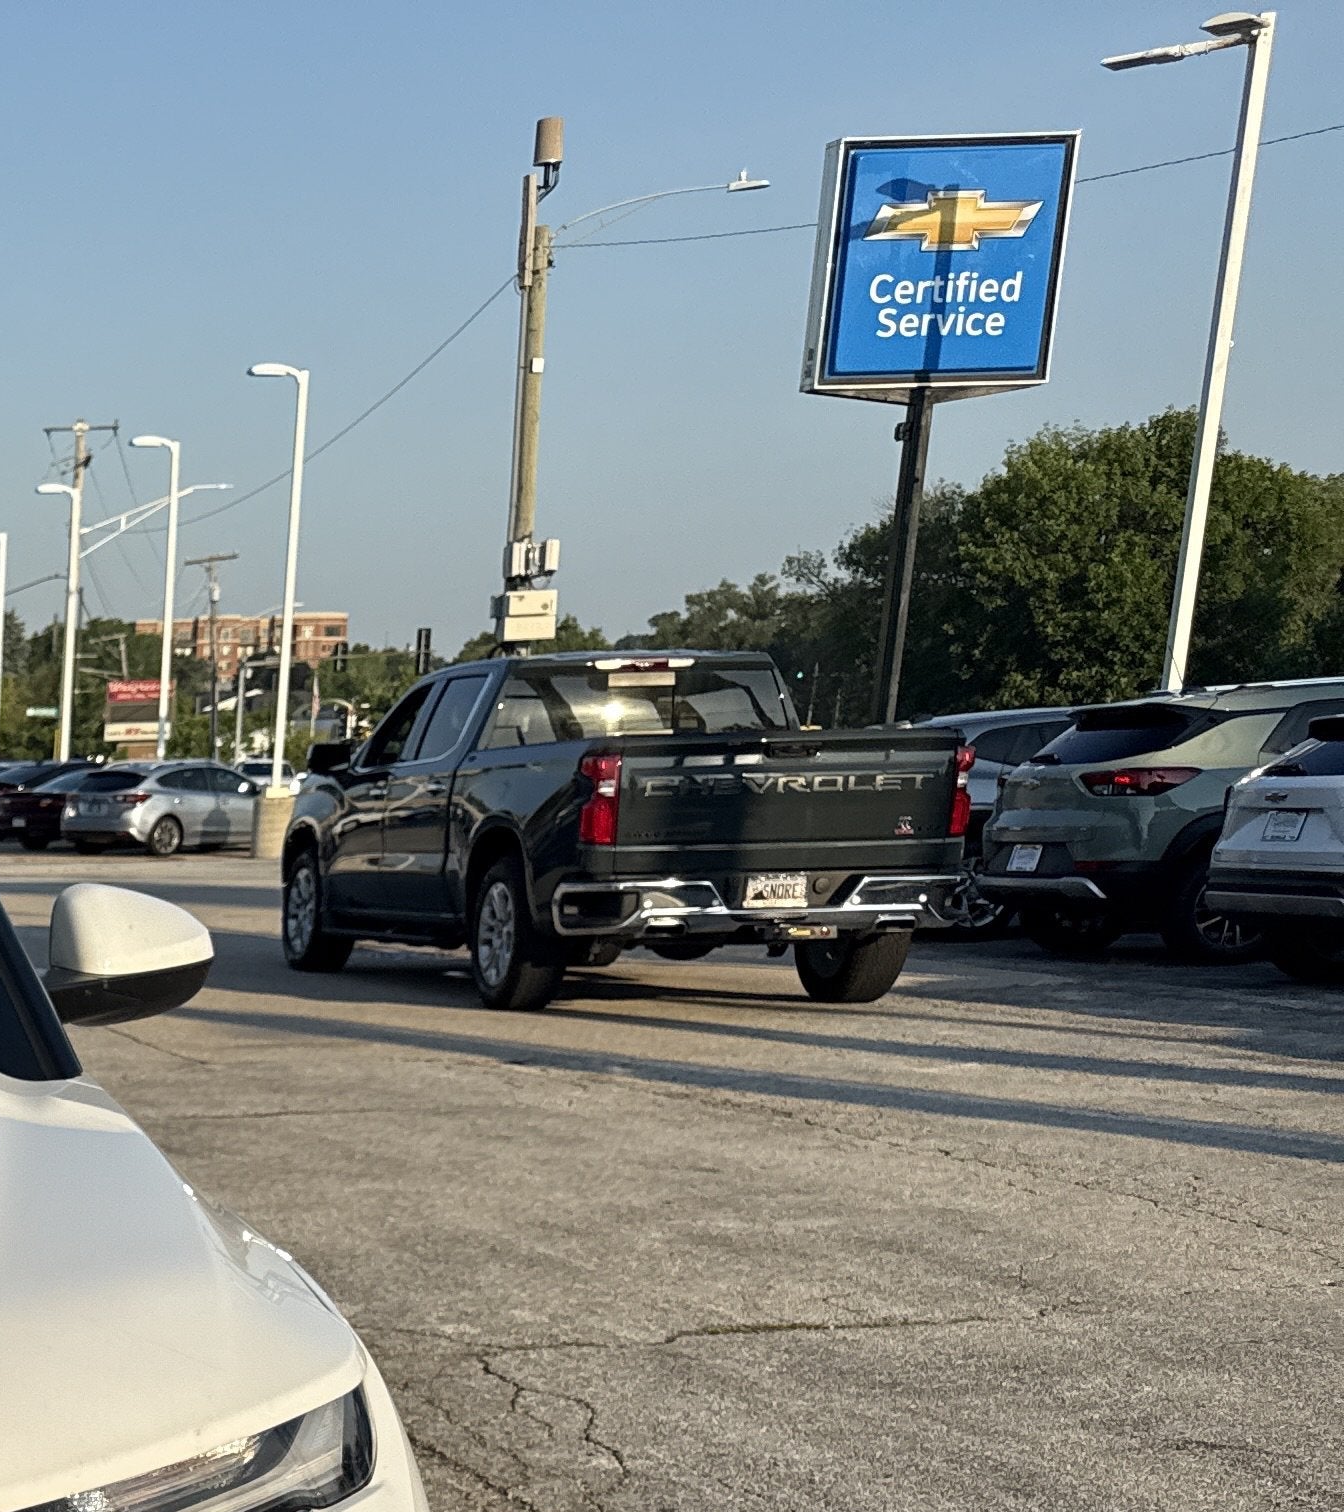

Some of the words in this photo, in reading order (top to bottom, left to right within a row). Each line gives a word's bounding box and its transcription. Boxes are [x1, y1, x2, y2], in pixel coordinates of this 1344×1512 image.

[869, 271, 1023, 304] Certified
[876, 306, 1005, 338] Service
[645, 773, 934, 797] CHEVROLET
